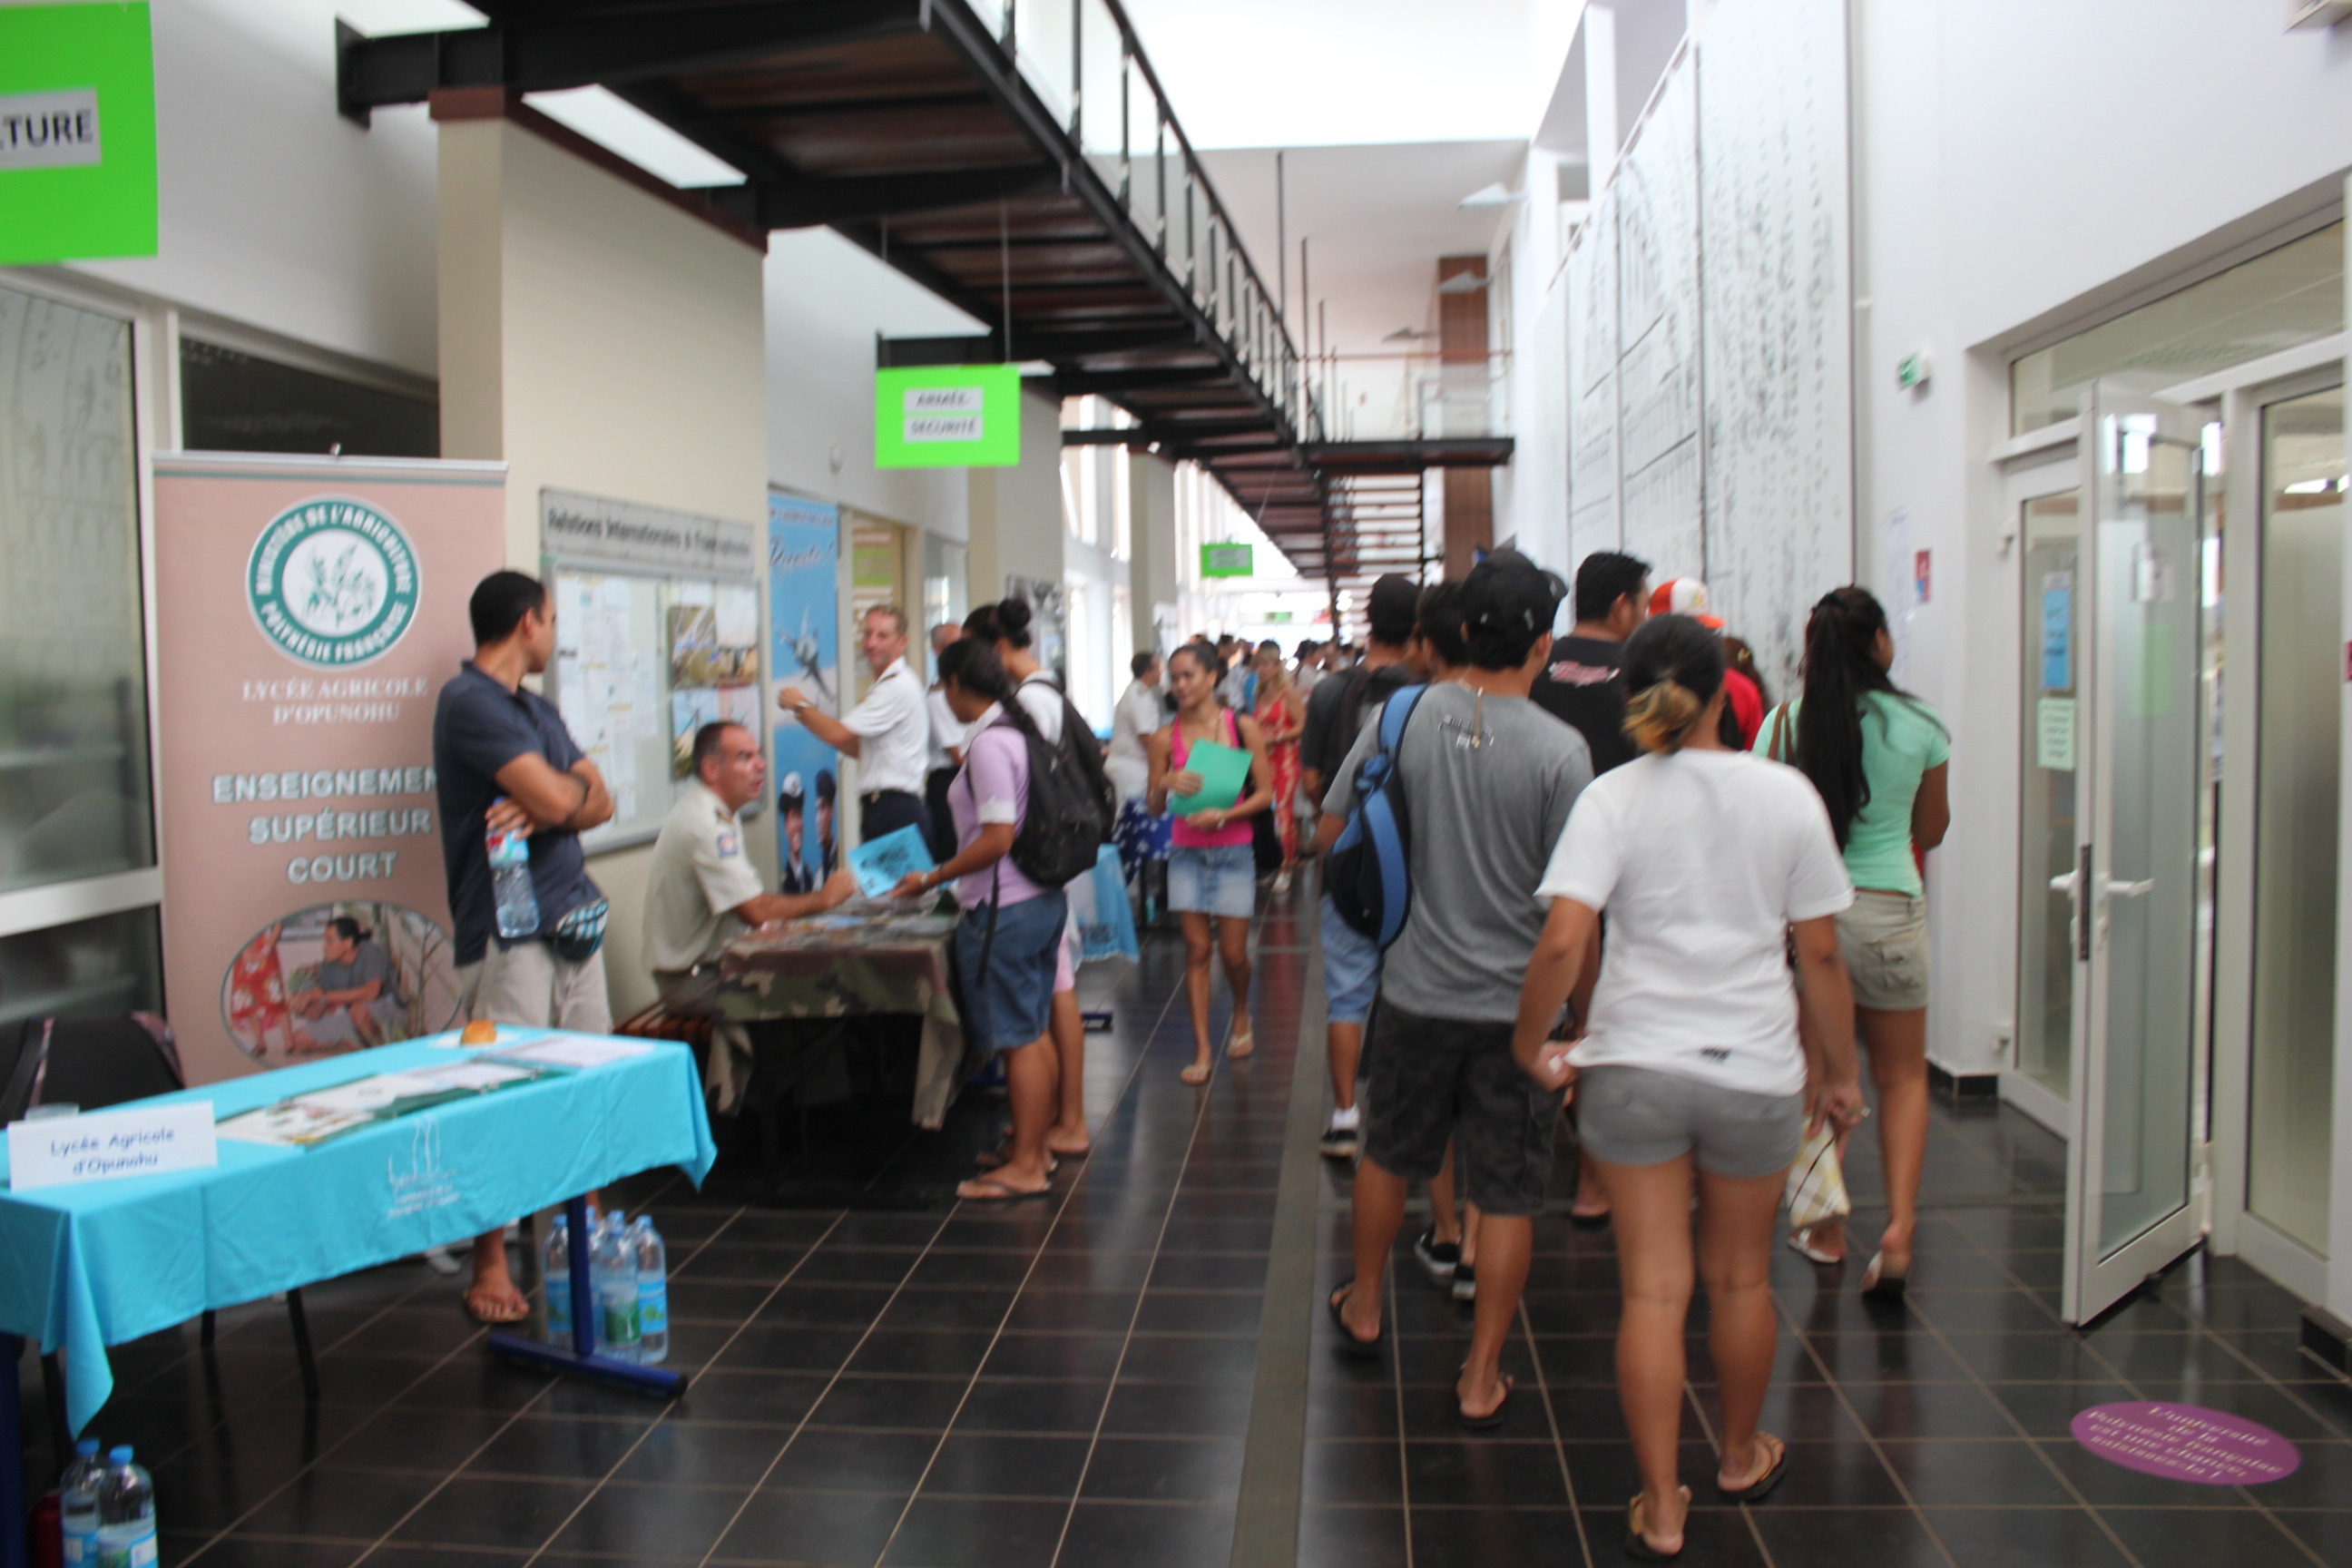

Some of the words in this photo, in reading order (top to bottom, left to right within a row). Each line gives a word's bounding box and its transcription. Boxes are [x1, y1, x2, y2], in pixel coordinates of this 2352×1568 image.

[305, 505, 328, 528] DE
[260, 601, 332, 662] POLYNÉSIE
[242, 675, 314, 701] LYCÉE
[318, 677, 429, 700] AGRICOLE
[273, 701, 401, 725] D'OPUNOHU
[249, 806, 433, 845] SUPÉRIEUR
[287, 850, 399, 885] COURT
[51, 1134, 99, 1158] Lycée
[108, 1126, 174, 1151] Agricole
[73, 1152, 159, 1176] d'Opunohu
